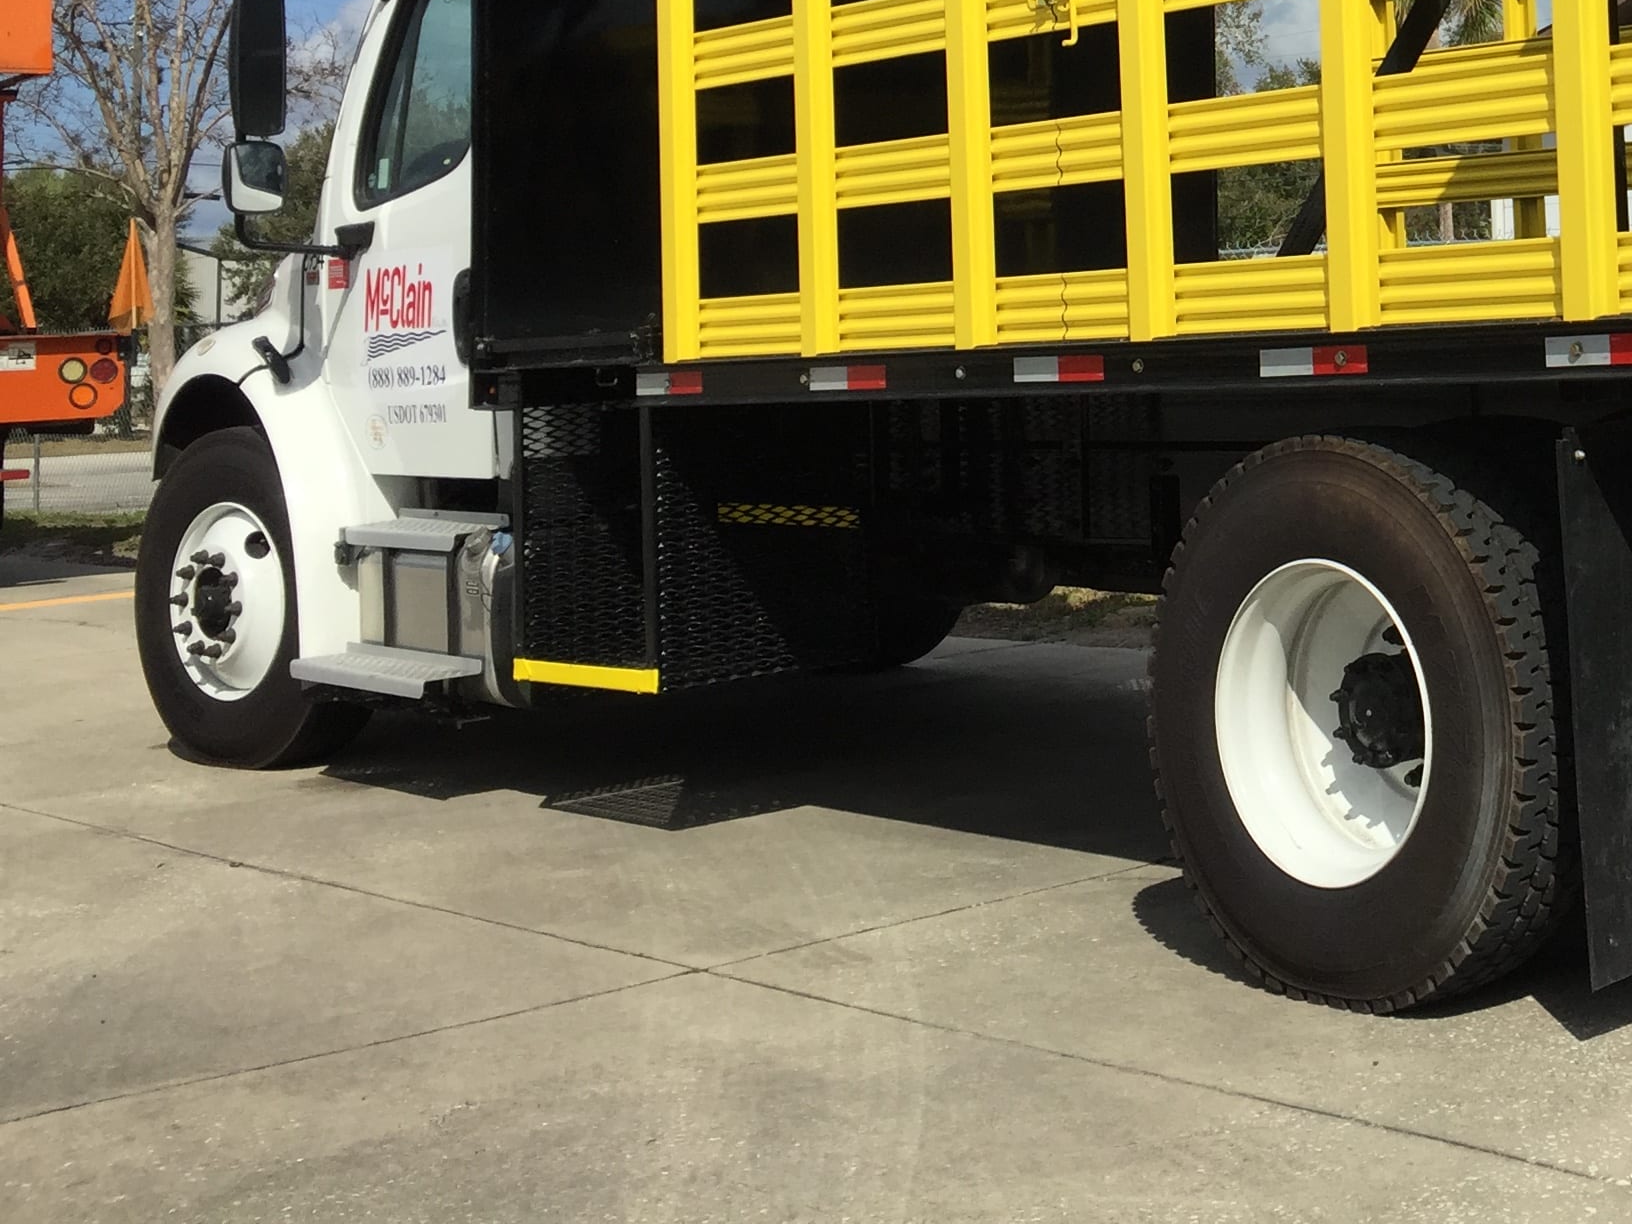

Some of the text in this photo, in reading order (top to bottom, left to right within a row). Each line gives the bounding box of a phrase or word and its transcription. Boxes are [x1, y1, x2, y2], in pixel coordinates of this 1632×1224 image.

[365, 263, 432, 332] McClain
[368, 364, 446, 389] (888) 889-1284
[388, 405, 418, 424] USDOT
